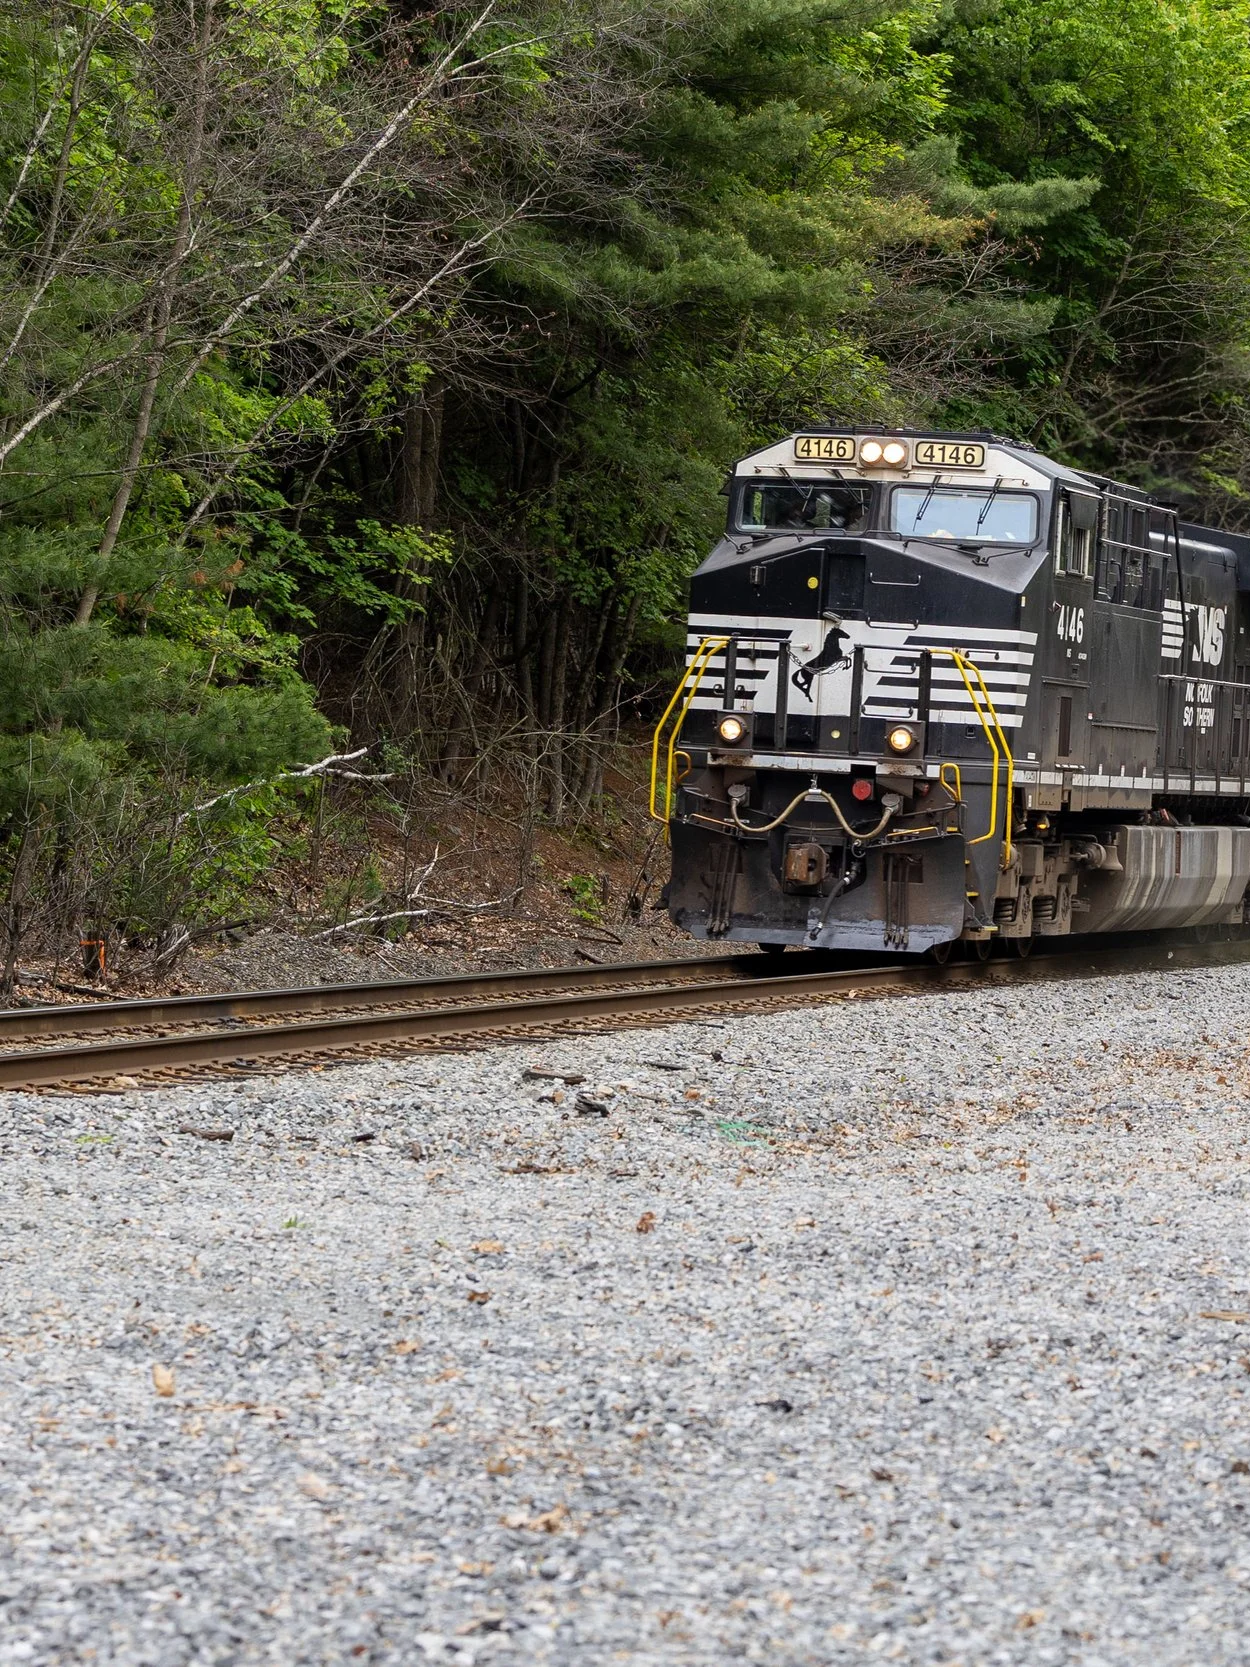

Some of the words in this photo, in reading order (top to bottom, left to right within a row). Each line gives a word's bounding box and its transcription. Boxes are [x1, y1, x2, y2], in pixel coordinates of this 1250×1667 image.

[800, 439, 847, 458] 4146
[922, 444, 976, 465] 4146
[1057, 604, 1085, 644] 4146
[1183, 706, 1215, 727] SOTHERN
